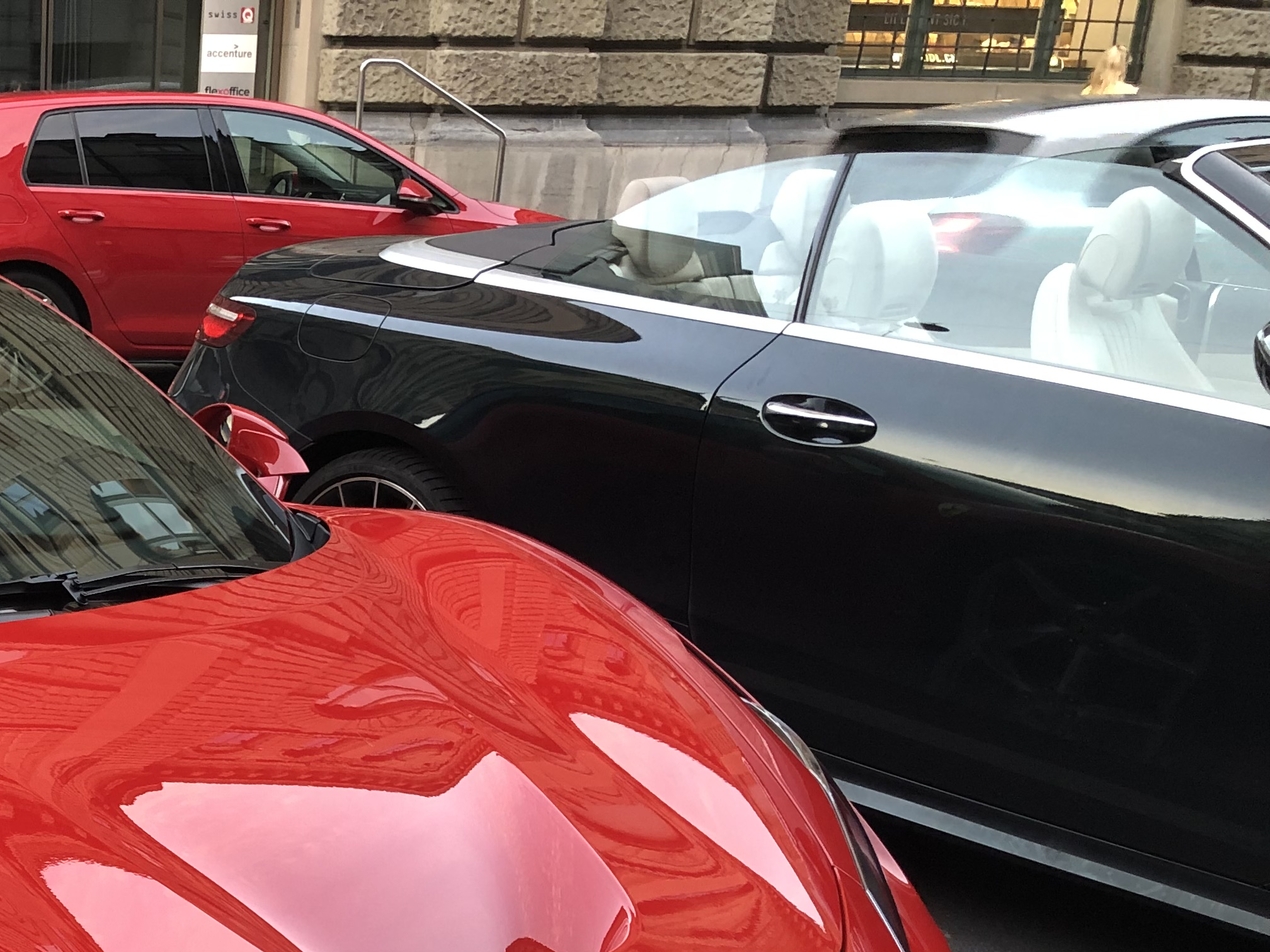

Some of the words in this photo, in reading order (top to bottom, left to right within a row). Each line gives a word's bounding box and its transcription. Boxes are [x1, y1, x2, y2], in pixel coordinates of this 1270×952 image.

[207, 10, 238, 19] swiss
[206, 49, 253, 59] accenture
[205, 86, 250, 97] flexoffice
